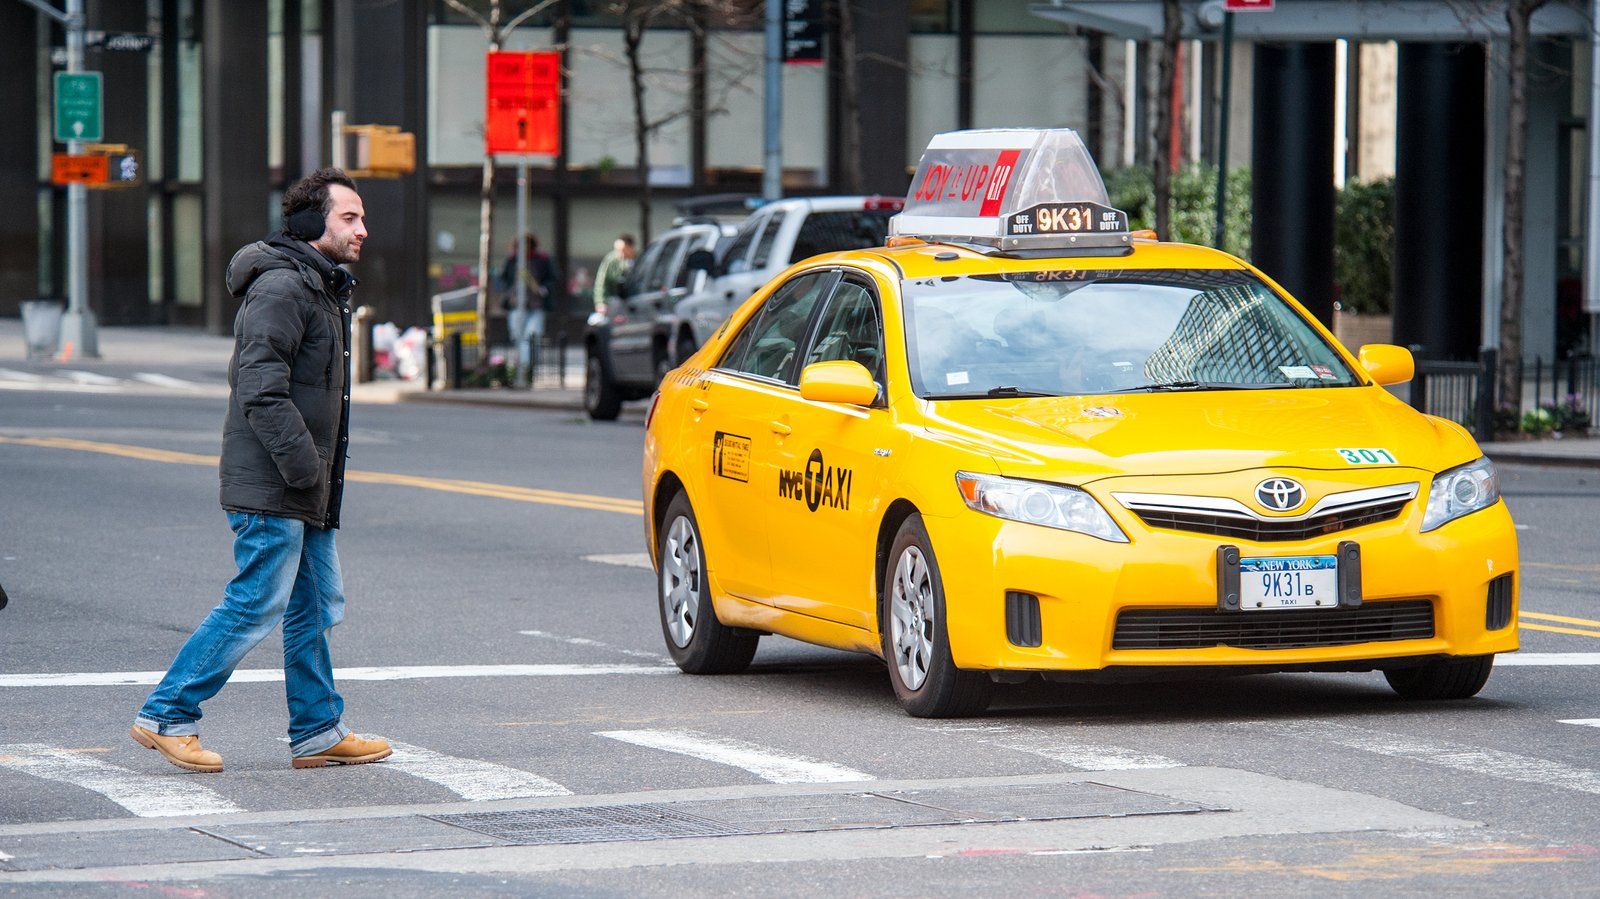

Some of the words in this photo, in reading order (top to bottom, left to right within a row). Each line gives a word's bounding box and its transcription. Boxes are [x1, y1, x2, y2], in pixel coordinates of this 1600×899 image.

[914, 164, 952, 201] JOY
[962, 165, 988, 201] UP
[1016, 215, 1029, 224] OFF
[1039, 207, 1092, 231] 9K31
[1103, 212, 1116, 221] OFF
[1013, 224, 1033, 233] DUTY
[1100, 221, 1120, 230] DUTY
[1340, 449, 1395, 464] 301
[779, 469, 803, 501] NYC
[805, 449, 852, 511] TAXI
[1262, 562, 1284, 571] NEW
[1287, 560, 1313, 570] YORK
